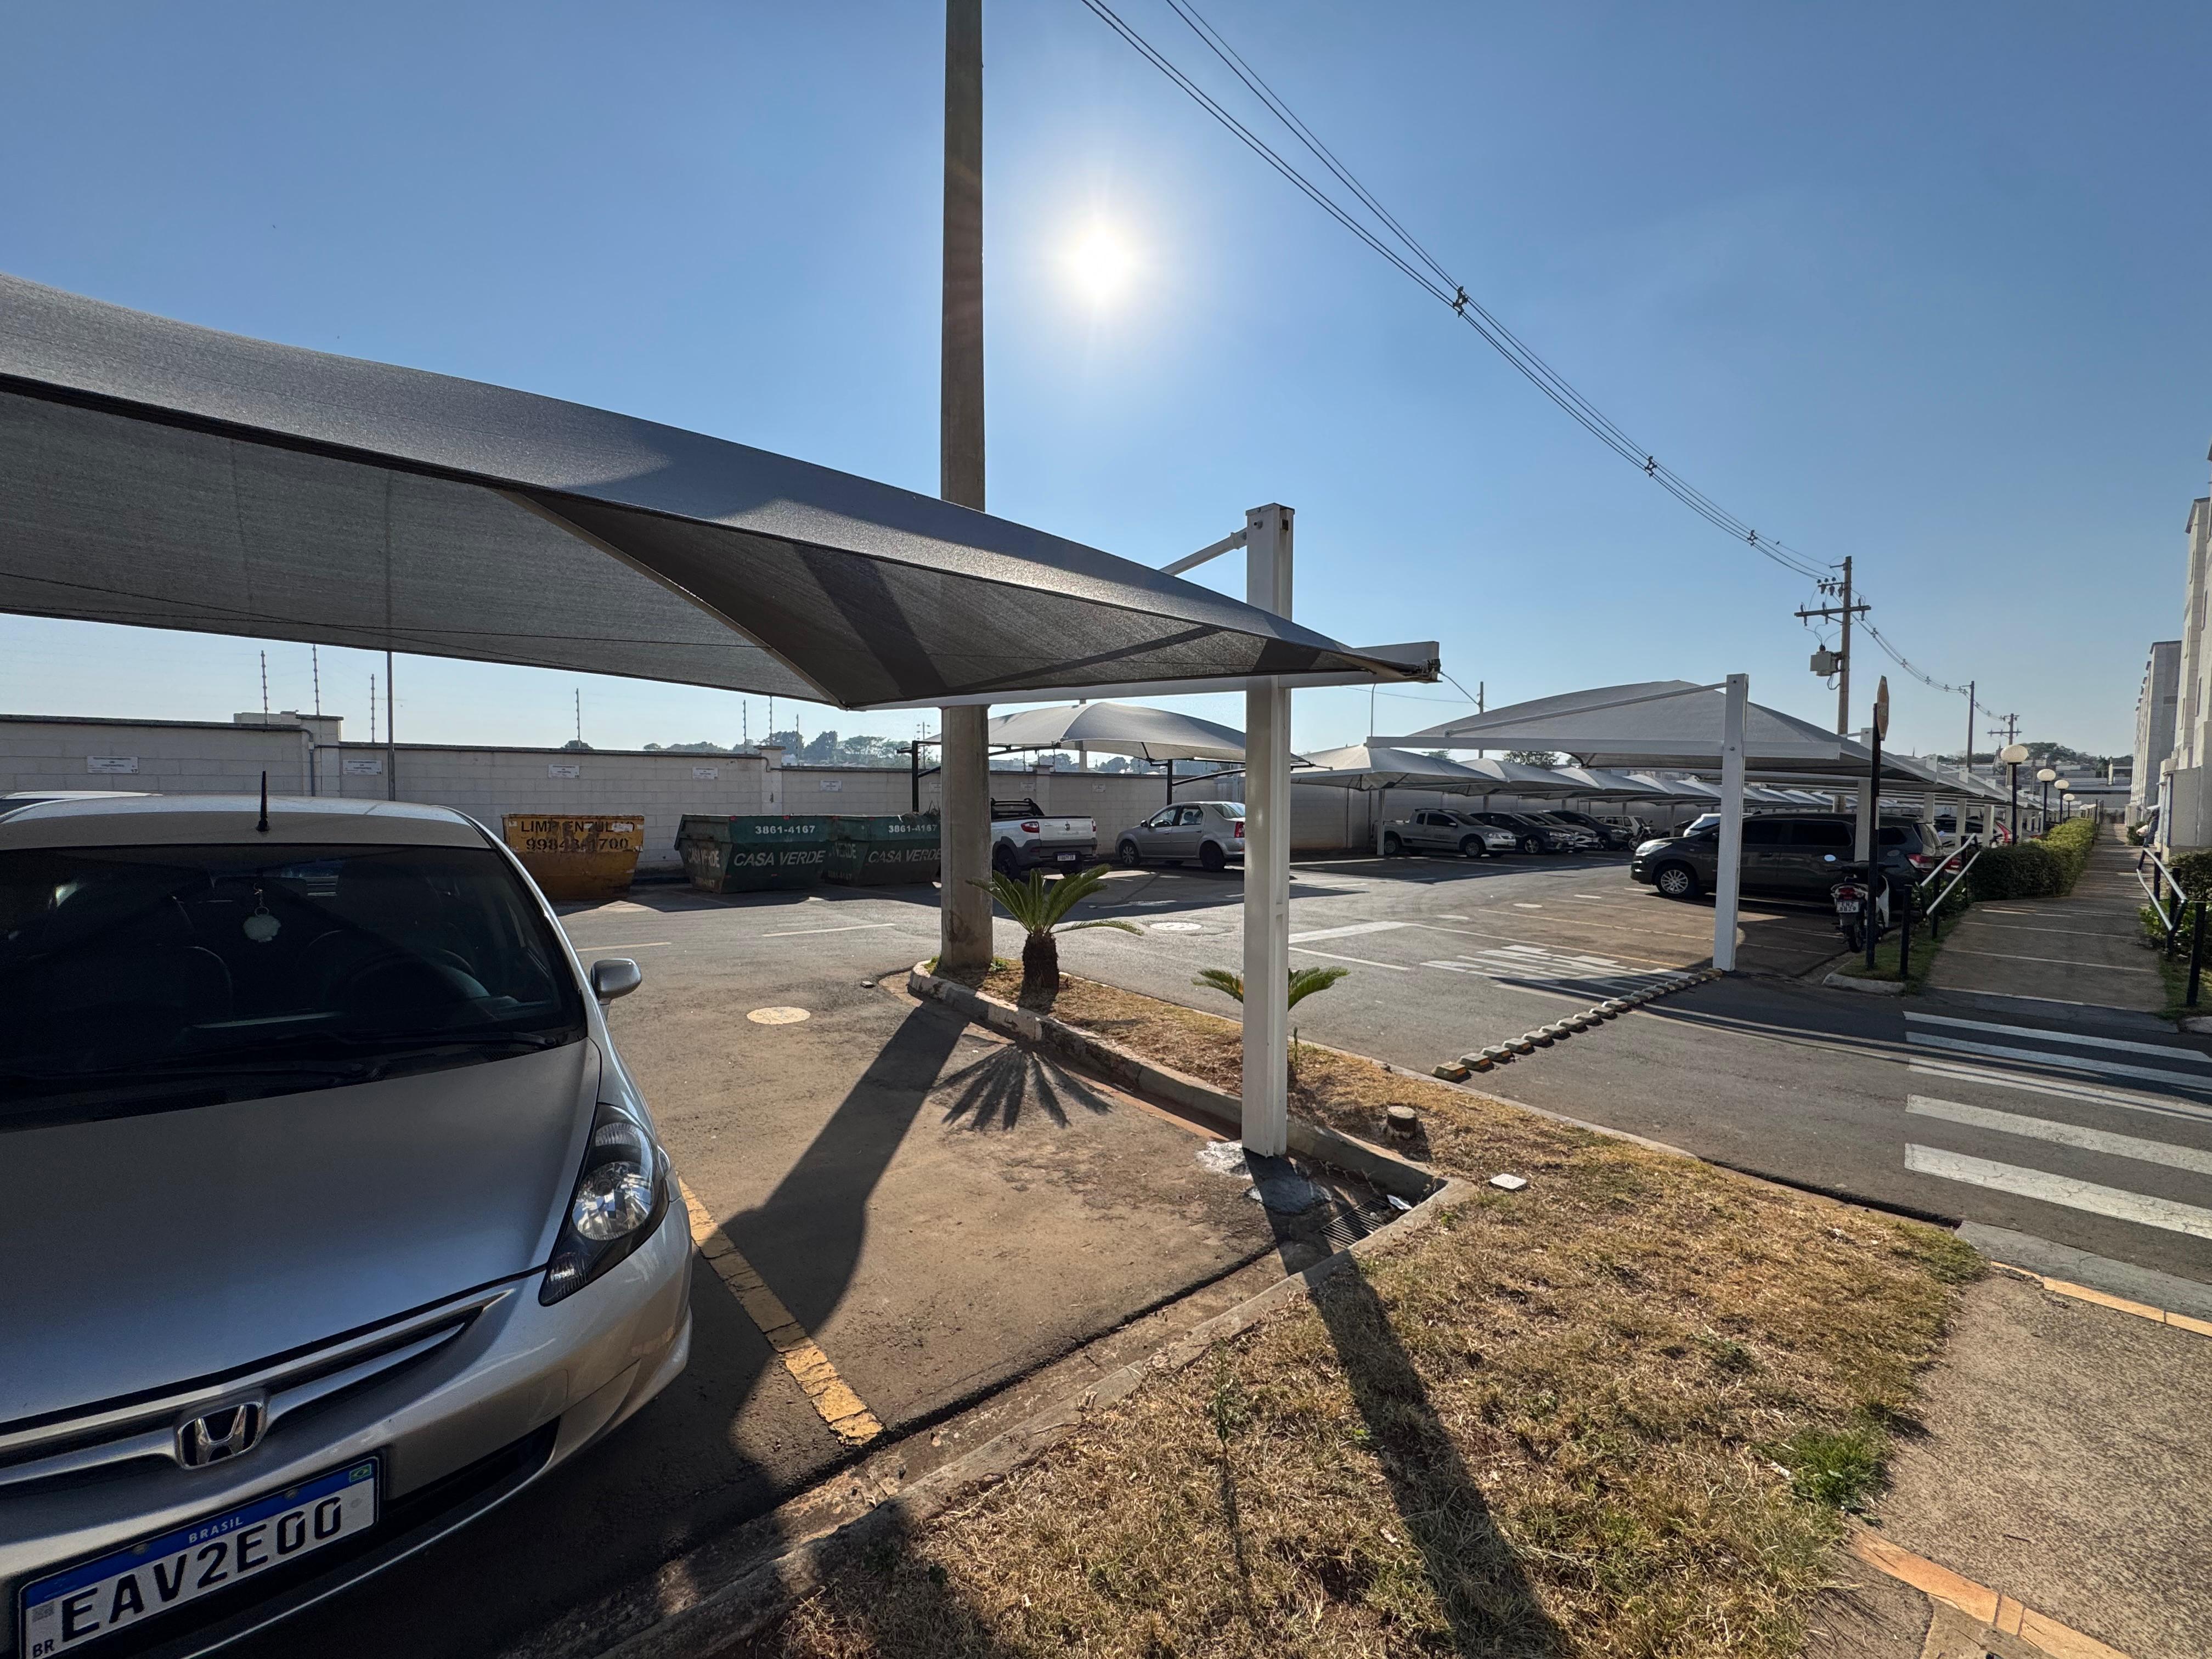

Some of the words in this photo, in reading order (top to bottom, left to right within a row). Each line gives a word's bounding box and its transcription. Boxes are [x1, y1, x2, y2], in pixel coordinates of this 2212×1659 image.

[755, 825, 816, 834] 3861-4167
[733, 851, 775, 867] CASA
[779, 850, 826, 865] VERDE
[868, 850, 901, 864] CASA
[906, 849, 941, 862] VERDE
[188, 1516, 244, 1544] BRASIL
[61, 1496, 342, 1643] EAV2E00
[32, 1638, 54, 1659] BR
